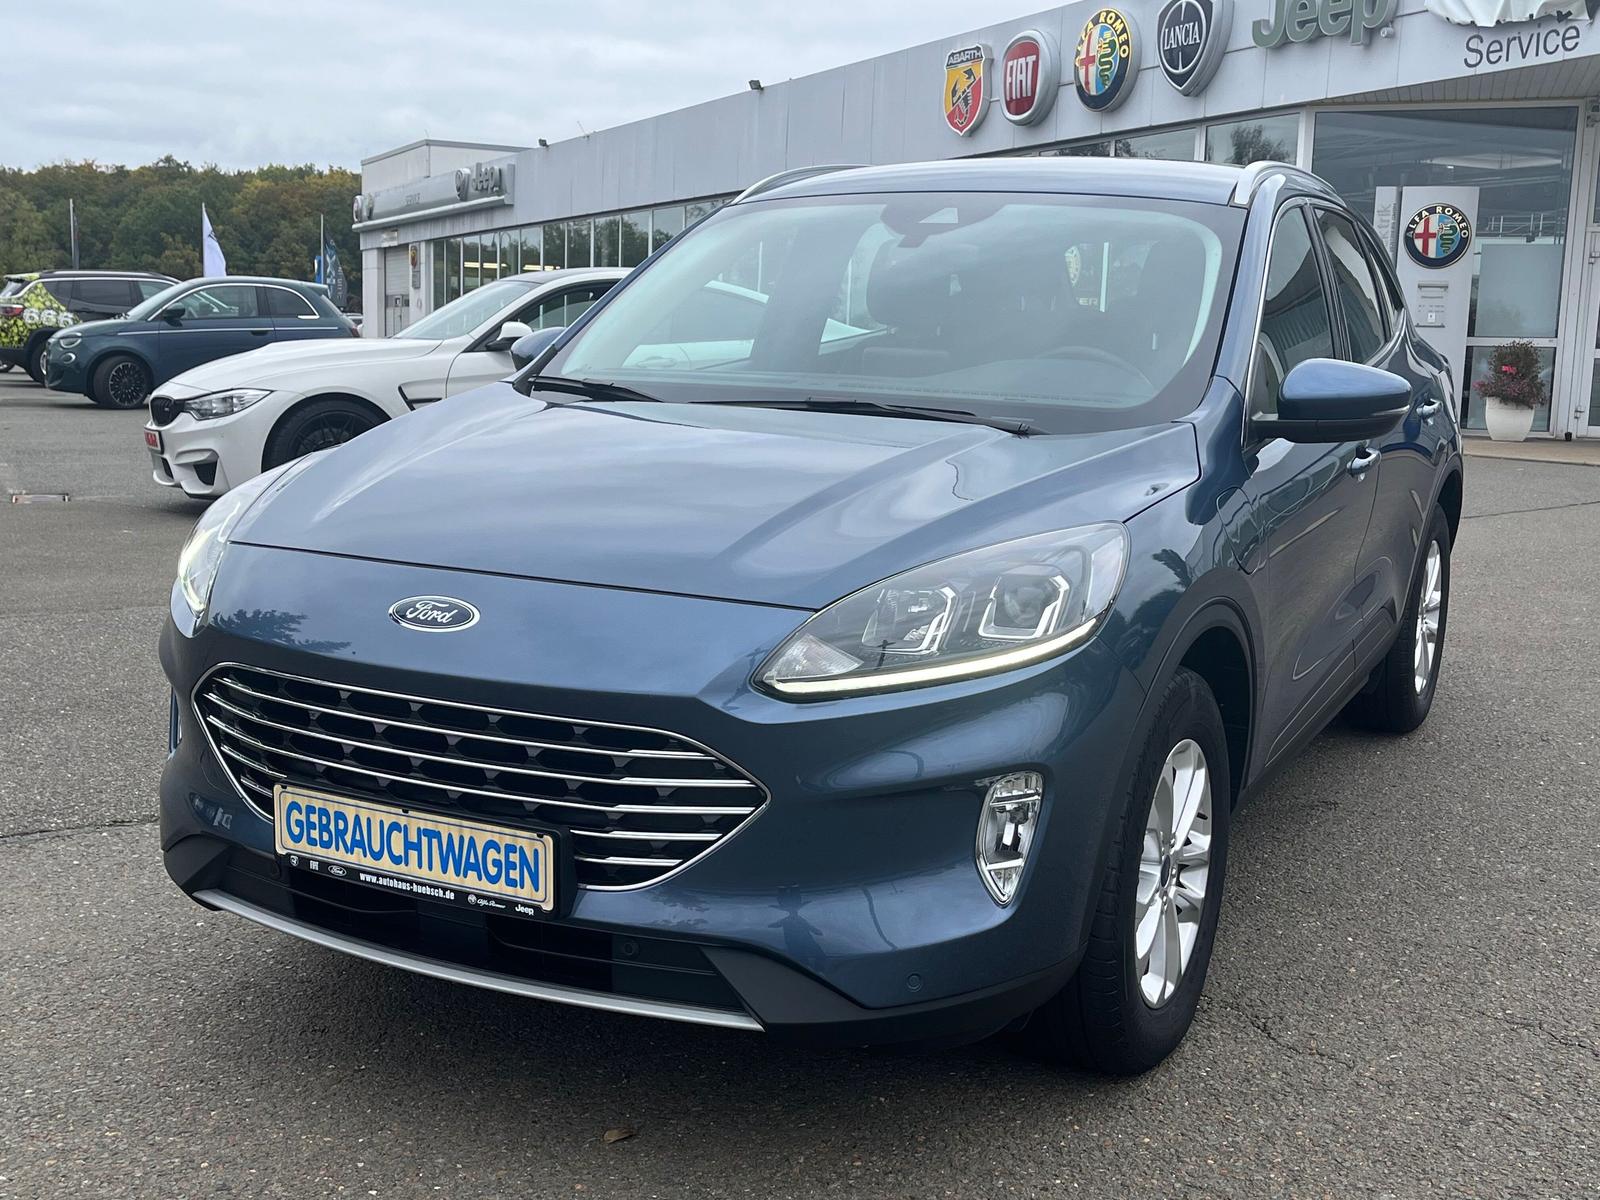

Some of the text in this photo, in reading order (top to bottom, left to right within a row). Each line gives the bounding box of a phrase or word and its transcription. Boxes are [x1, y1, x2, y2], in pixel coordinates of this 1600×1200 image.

[1099, 11, 1130, 59] ROMEO
[1163, 20, 1201, 50] LANCIA
[1252, 0, 1392, 48] Jeep
[947, 50, 982, 65] ABARTH
[1463, 23, 1581, 69] Service
[1006, 55, 1037, 101] FIAT
[472, 162, 496, 193] Jeep
[1406, 210, 1430, 238] ALFA
[1436, 206, 1469, 238] ROMEO
[406, 600, 458, 623] Ford
[286, 801, 540, 893] GEBRAUCHTWAGEN
[359, 872, 455, 900] www.autohaus-huebsch.de
[515, 904, 535, 916] Jeep
